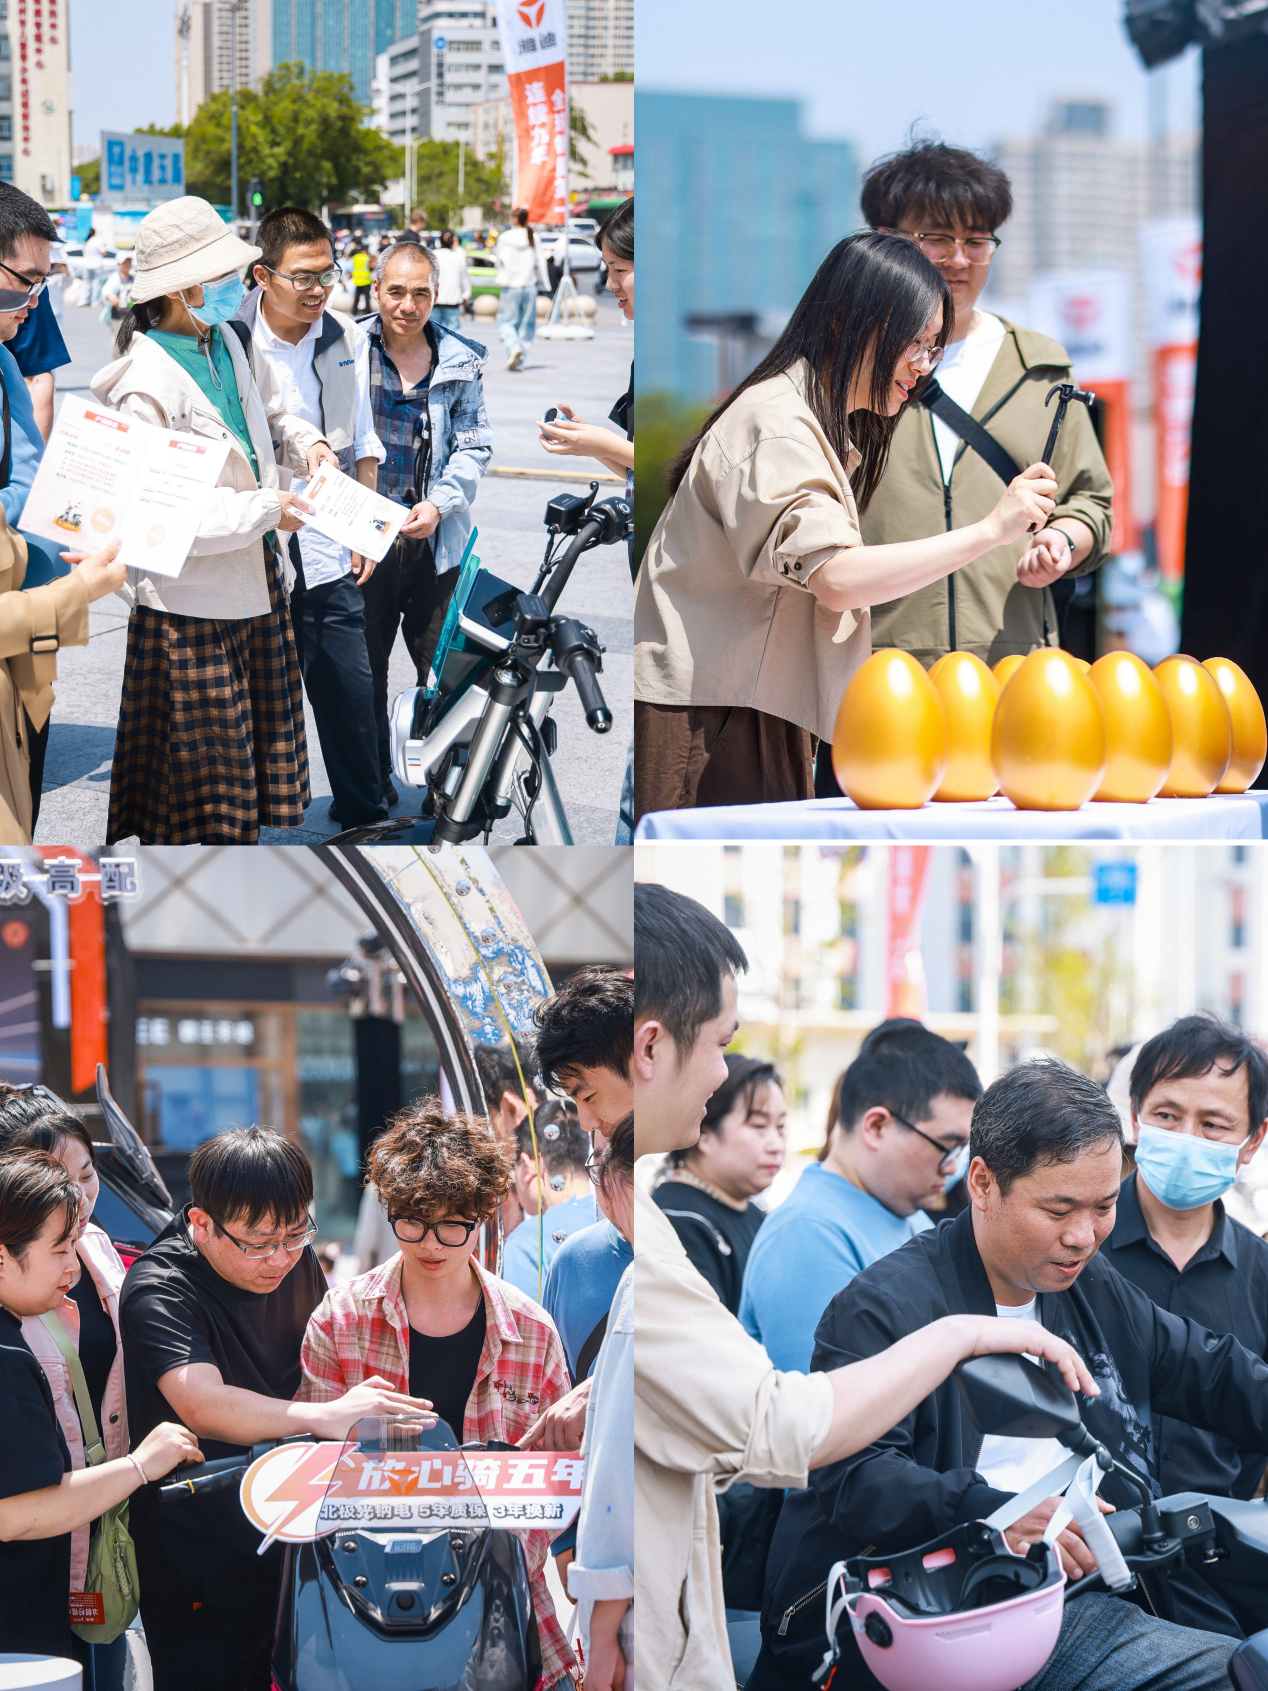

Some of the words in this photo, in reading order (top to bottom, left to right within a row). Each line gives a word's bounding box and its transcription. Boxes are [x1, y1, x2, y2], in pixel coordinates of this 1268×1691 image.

[357, 1458, 584, 1491] 放心骑五年
[320, 1504, 413, 1520] 北极光钠电
[418, 1504, 487, 1520] 5年质保
[492, 1503, 563, 1519] 3年换新
